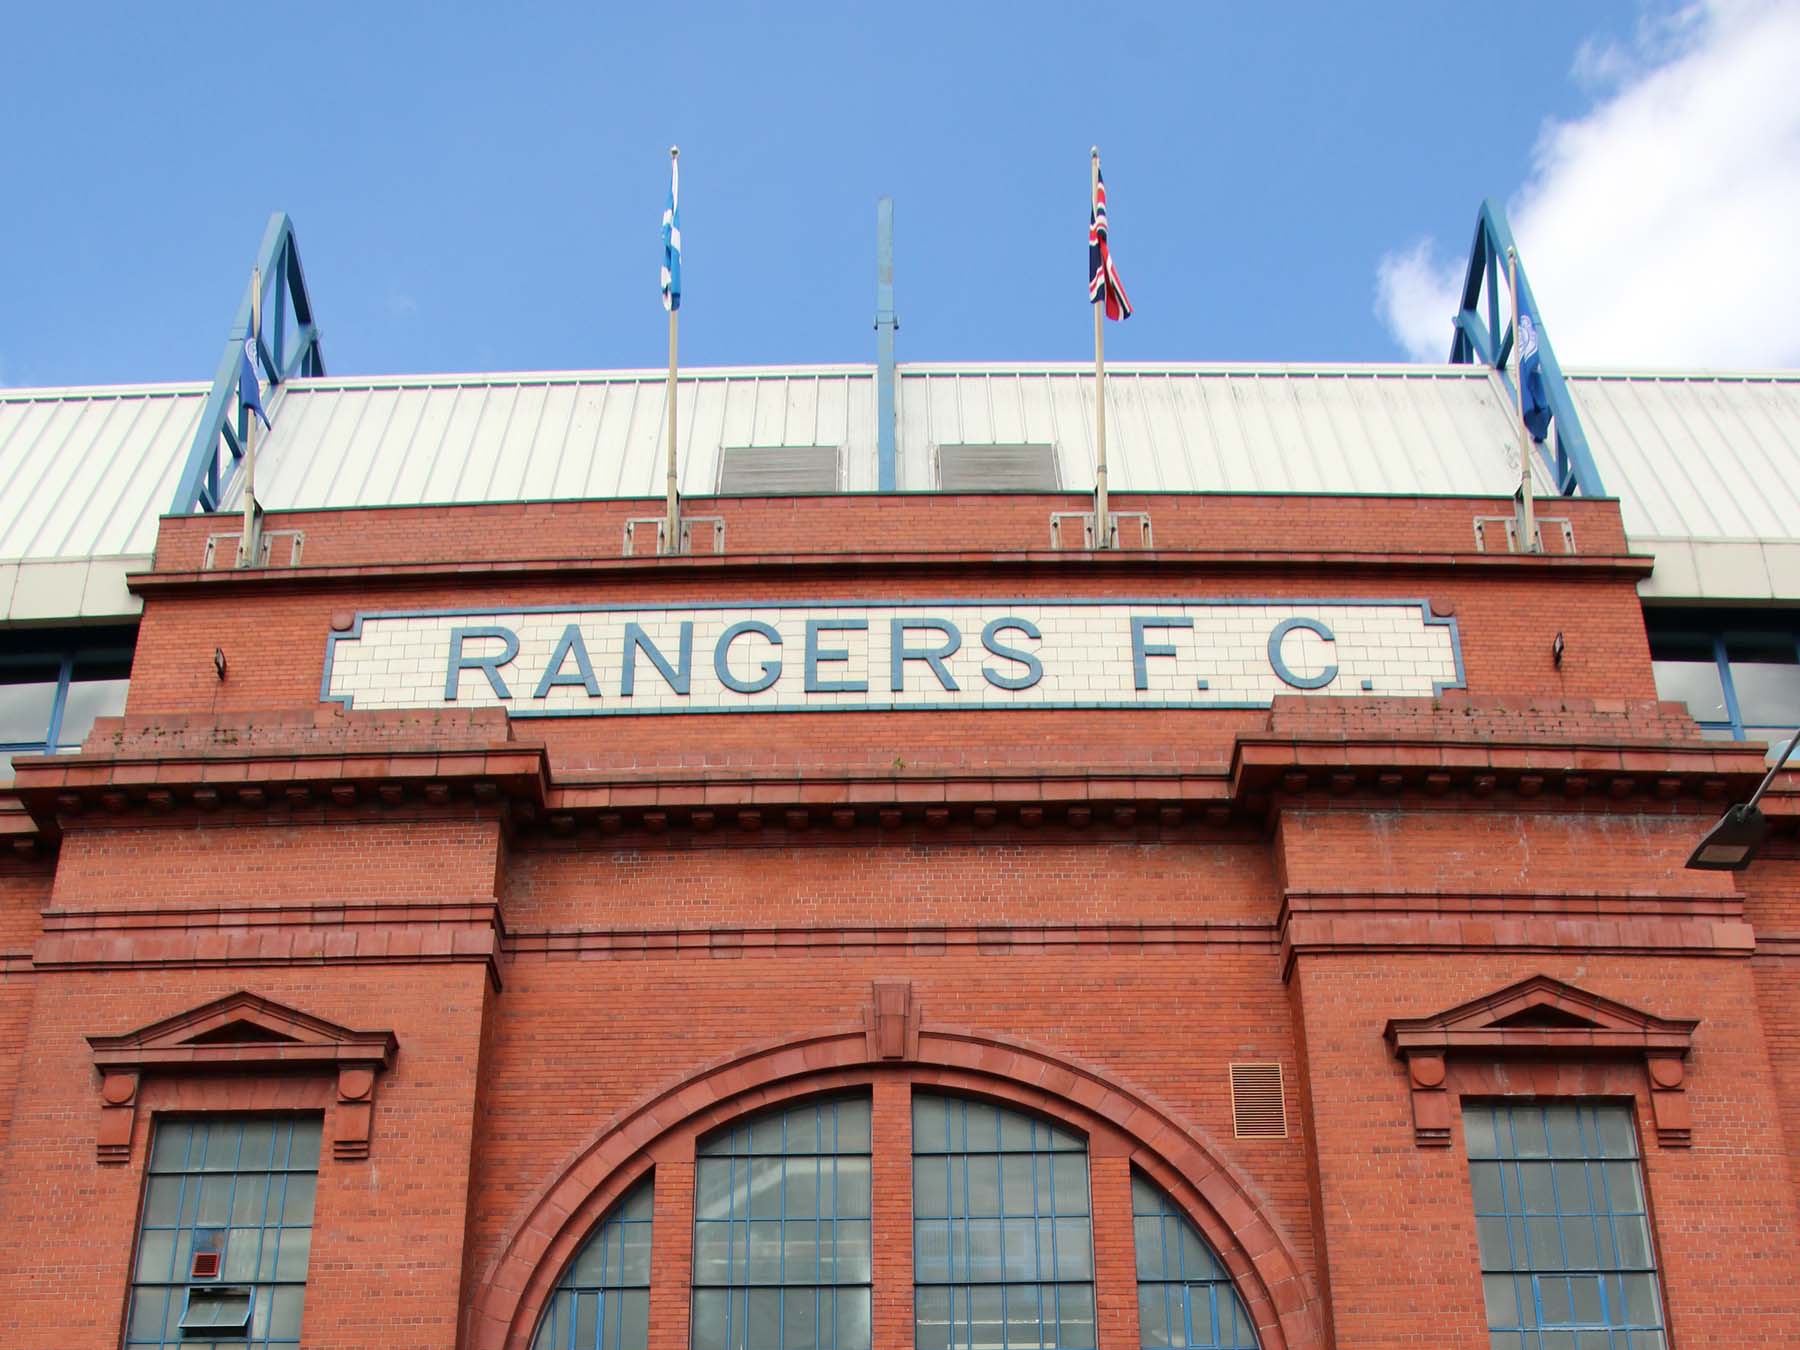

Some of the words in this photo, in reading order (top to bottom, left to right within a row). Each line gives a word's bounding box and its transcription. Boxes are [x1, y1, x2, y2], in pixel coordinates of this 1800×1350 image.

[444, 616, 1043, 700] RANGERS
[1131, 615, 1209, 690] F.
[1267, 616, 1374, 690] C.
